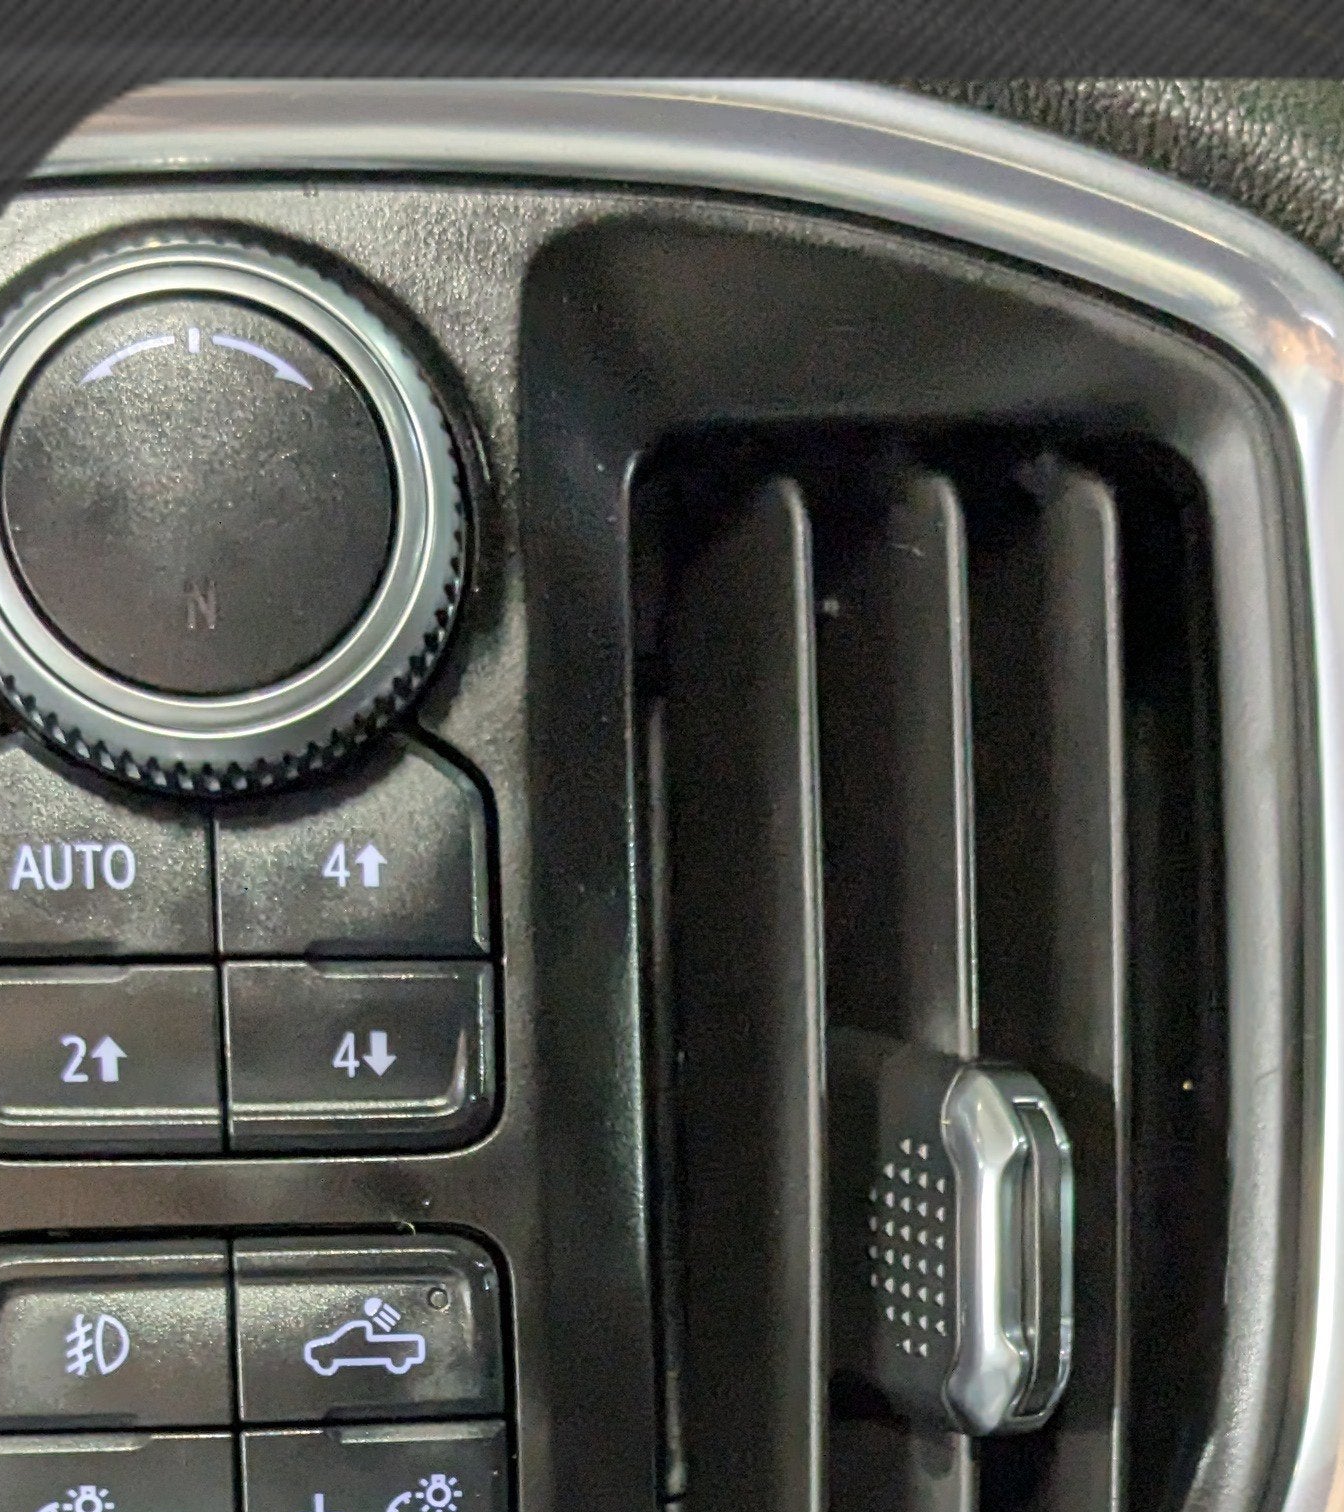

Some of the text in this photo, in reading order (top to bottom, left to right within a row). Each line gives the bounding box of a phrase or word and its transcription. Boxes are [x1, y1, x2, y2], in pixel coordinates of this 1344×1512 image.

[12, 843, 137, 890] AUTO
[322, 844, 351, 888] 4
[60, 1035, 89, 1083] 2
[332, 1031, 360, 1078] 4
